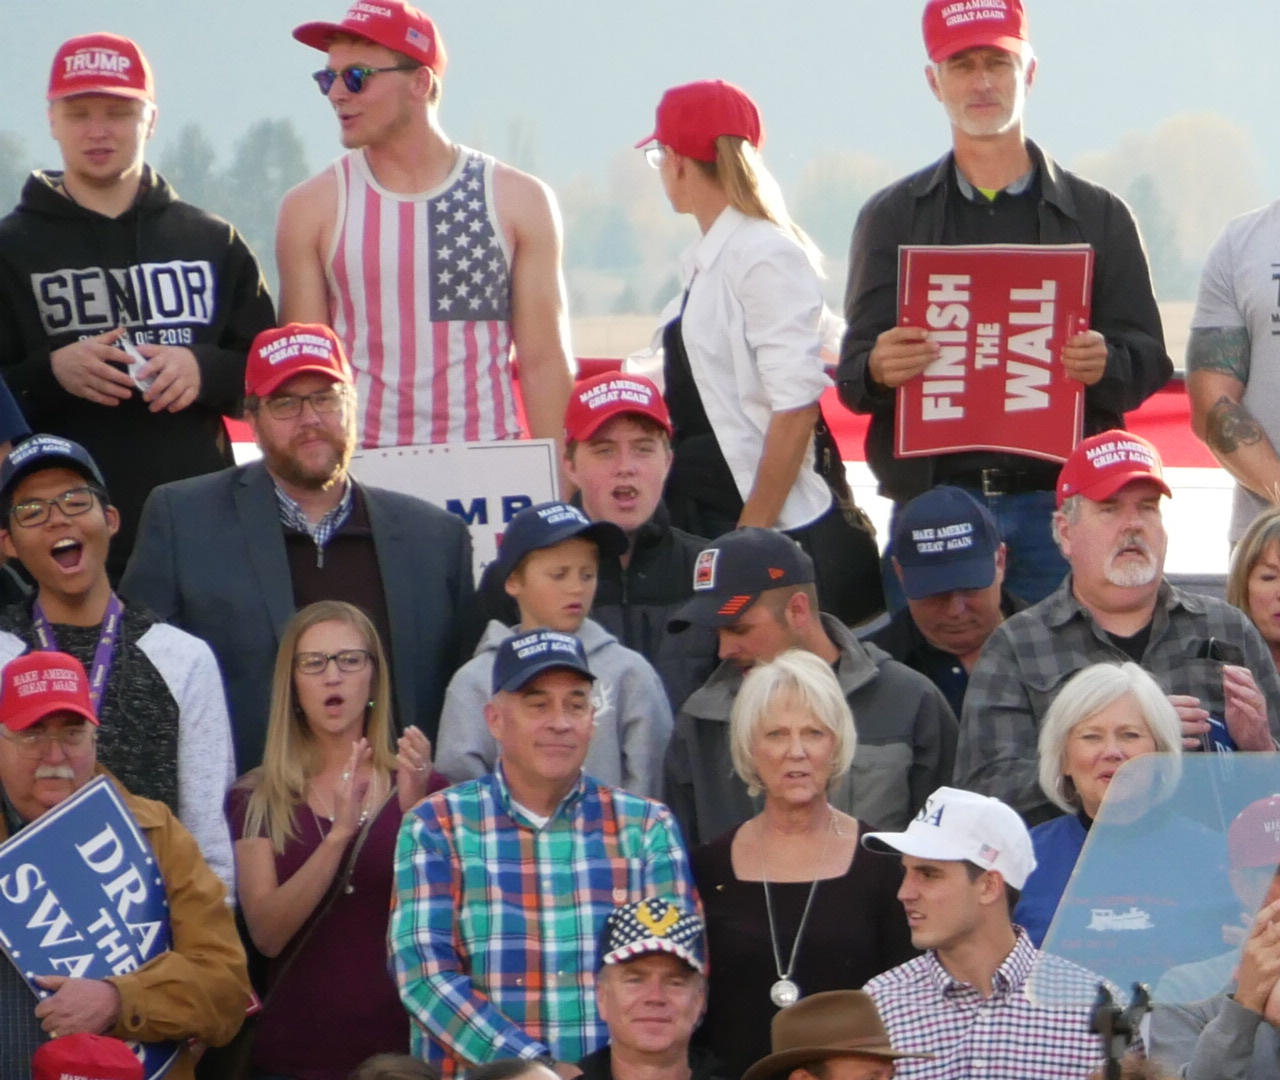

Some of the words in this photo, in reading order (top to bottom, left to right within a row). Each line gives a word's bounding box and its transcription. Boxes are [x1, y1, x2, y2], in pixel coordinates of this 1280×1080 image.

[942, 3, 964, 18] MAKE
[946, 12, 975, 26] GREAT
[976, 9, 1005, 19] AGAIN
[63, 52, 130, 72] TRUMP
[40, 259, 212, 327] SENIOR
[158, 328, 192, 344] 2019
[259, 337, 288, 358] MAKE
[289, 334, 332, 349] AMERICA
[976, 323, 1000, 369] THE
[1004, 280, 1057, 412] WALL
[269, 345, 301, 365] GREAT
[302, 345, 330, 359] AGAIN
[922, 274, 971, 421] FINISH
[580, 383, 608, 403] MAKE
[609, 380, 652, 396] AMERICA
[588, 390, 619, 409] GREAT
[620, 391, 649, 405] AGAIN
[9, 442, 30, 460] MAKE
[32, 437, 72, 449] AMERICA
[12, 446, 39, 465] GREAT
[43, 444, 70, 453] AGAIN
[1086, 441, 1116, 459] MAKE
[1093, 452, 1128, 468] GREAT
[1129, 452, 1154, 467] AGAIN
[912, 528, 935, 540] MAKE
[917, 541, 944, 553] GREAT
[945, 536, 972, 551] AGAIN
[512, 634, 538, 650] MAKE
[518, 642, 548, 659] GREAT
[13, 671, 38, 686] MAKE
[42, 668, 79, 681] AMERICA
[18, 681, 47, 697] GREAT
[52, 680, 77, 692] AGAIN
[75, 827, 162, 959] DRA
[1, 863, 95, 979] SWA
[85, 907, 137, 977] THE
